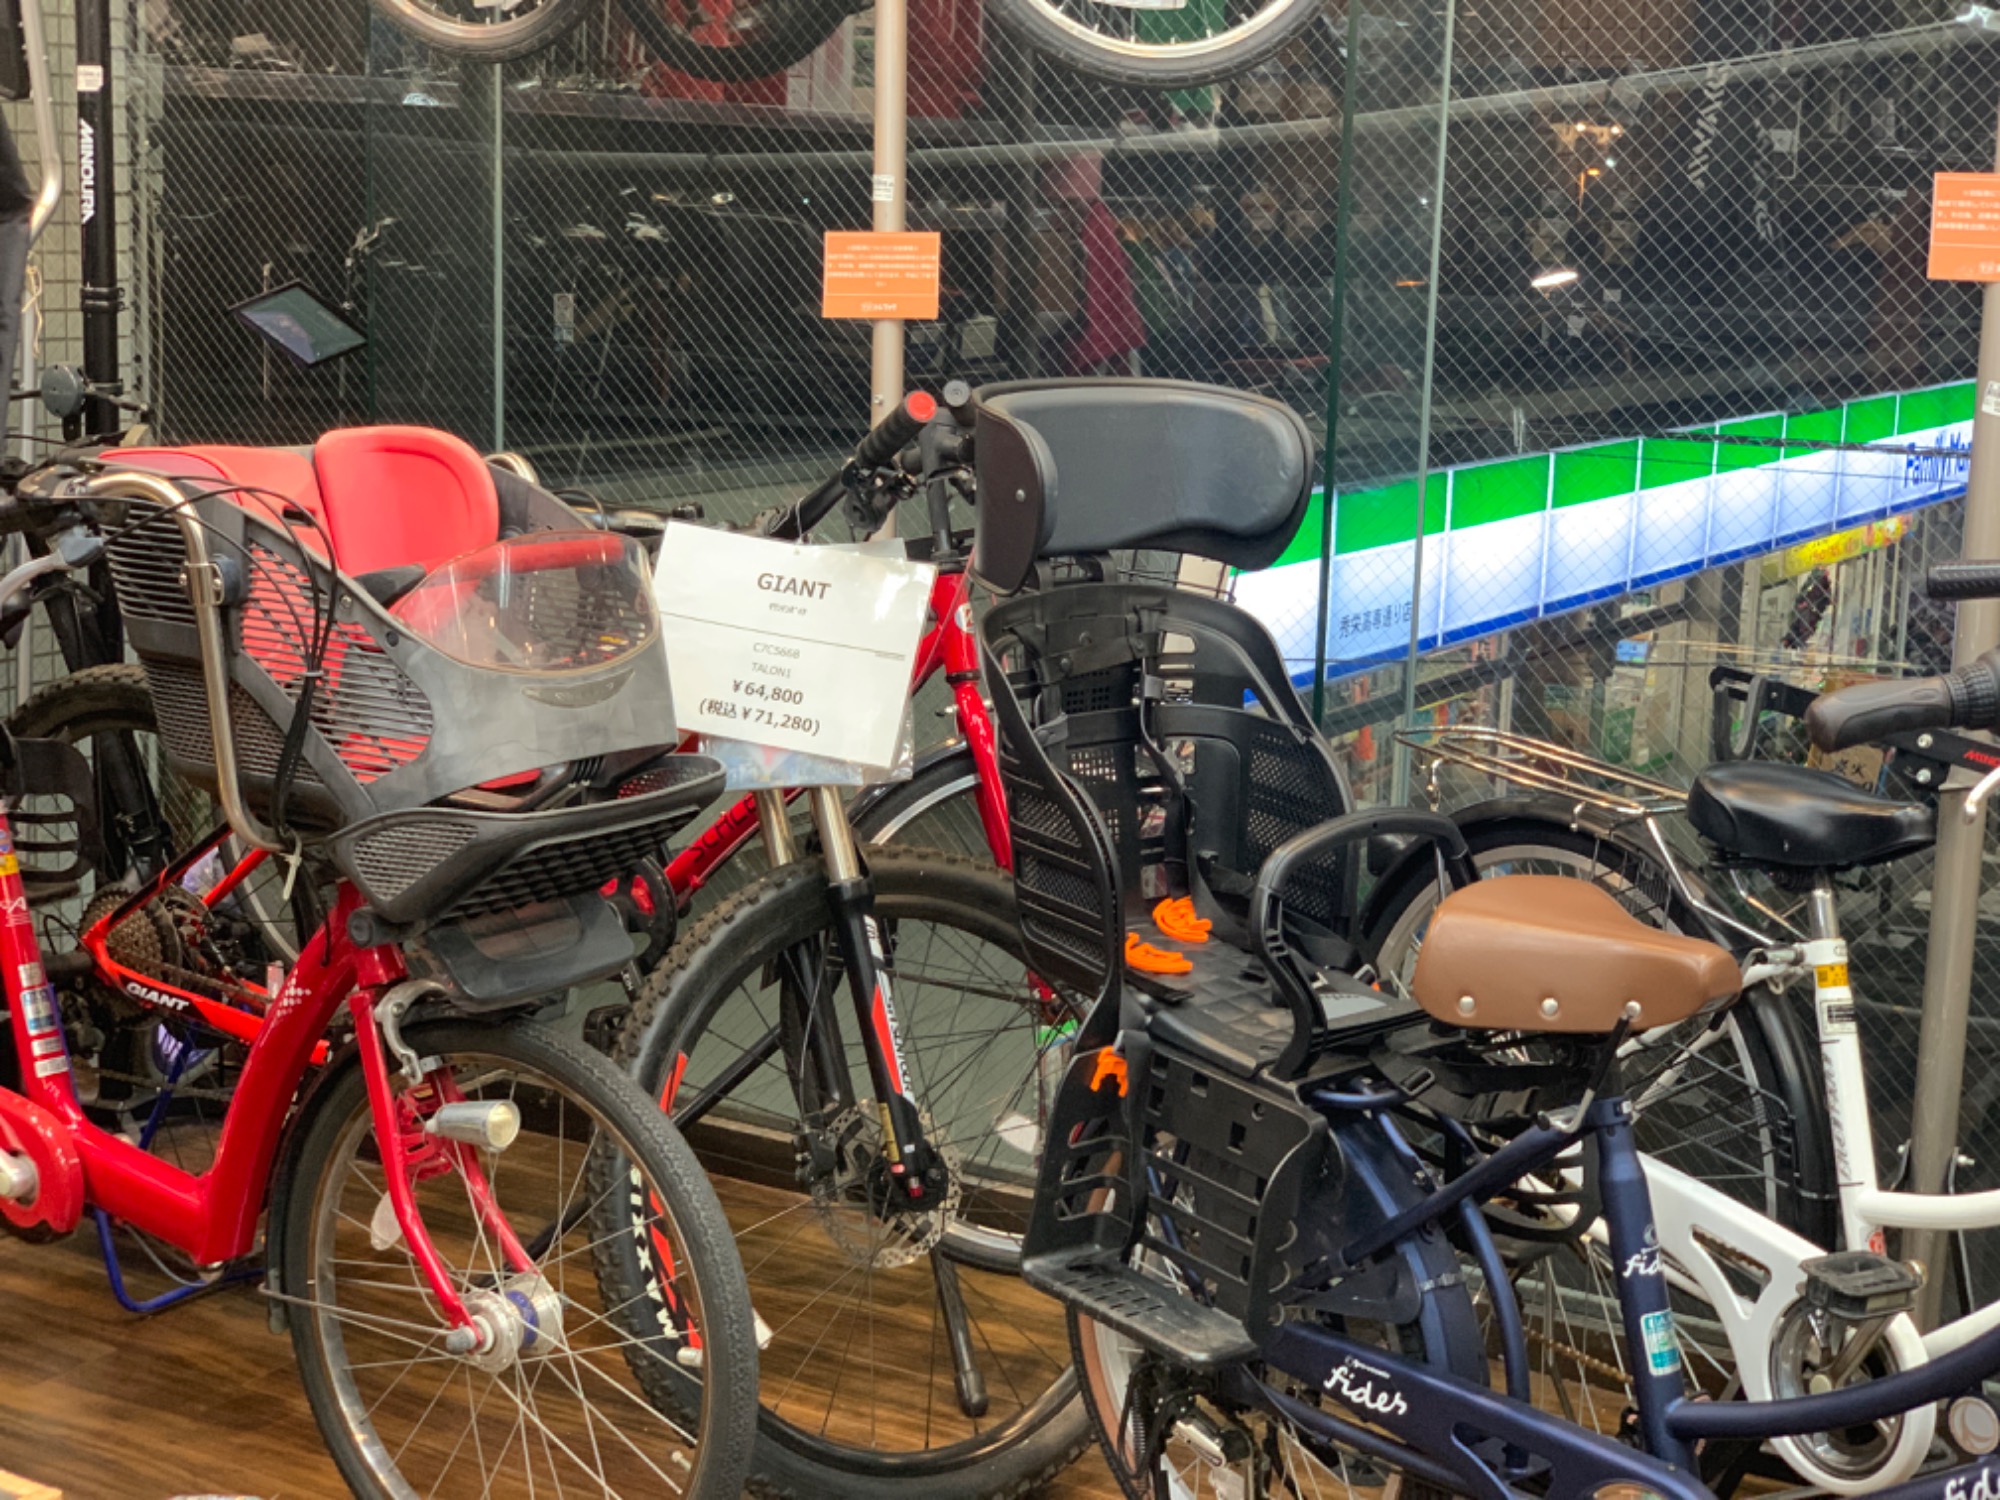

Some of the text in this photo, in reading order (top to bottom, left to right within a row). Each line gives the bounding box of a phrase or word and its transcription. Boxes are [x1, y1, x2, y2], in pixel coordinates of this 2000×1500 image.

[80, 118, 95, 225] MINOURA
[757, 573, 832, 600] GIANT
[126, 981, 190, 1011] GIANT
